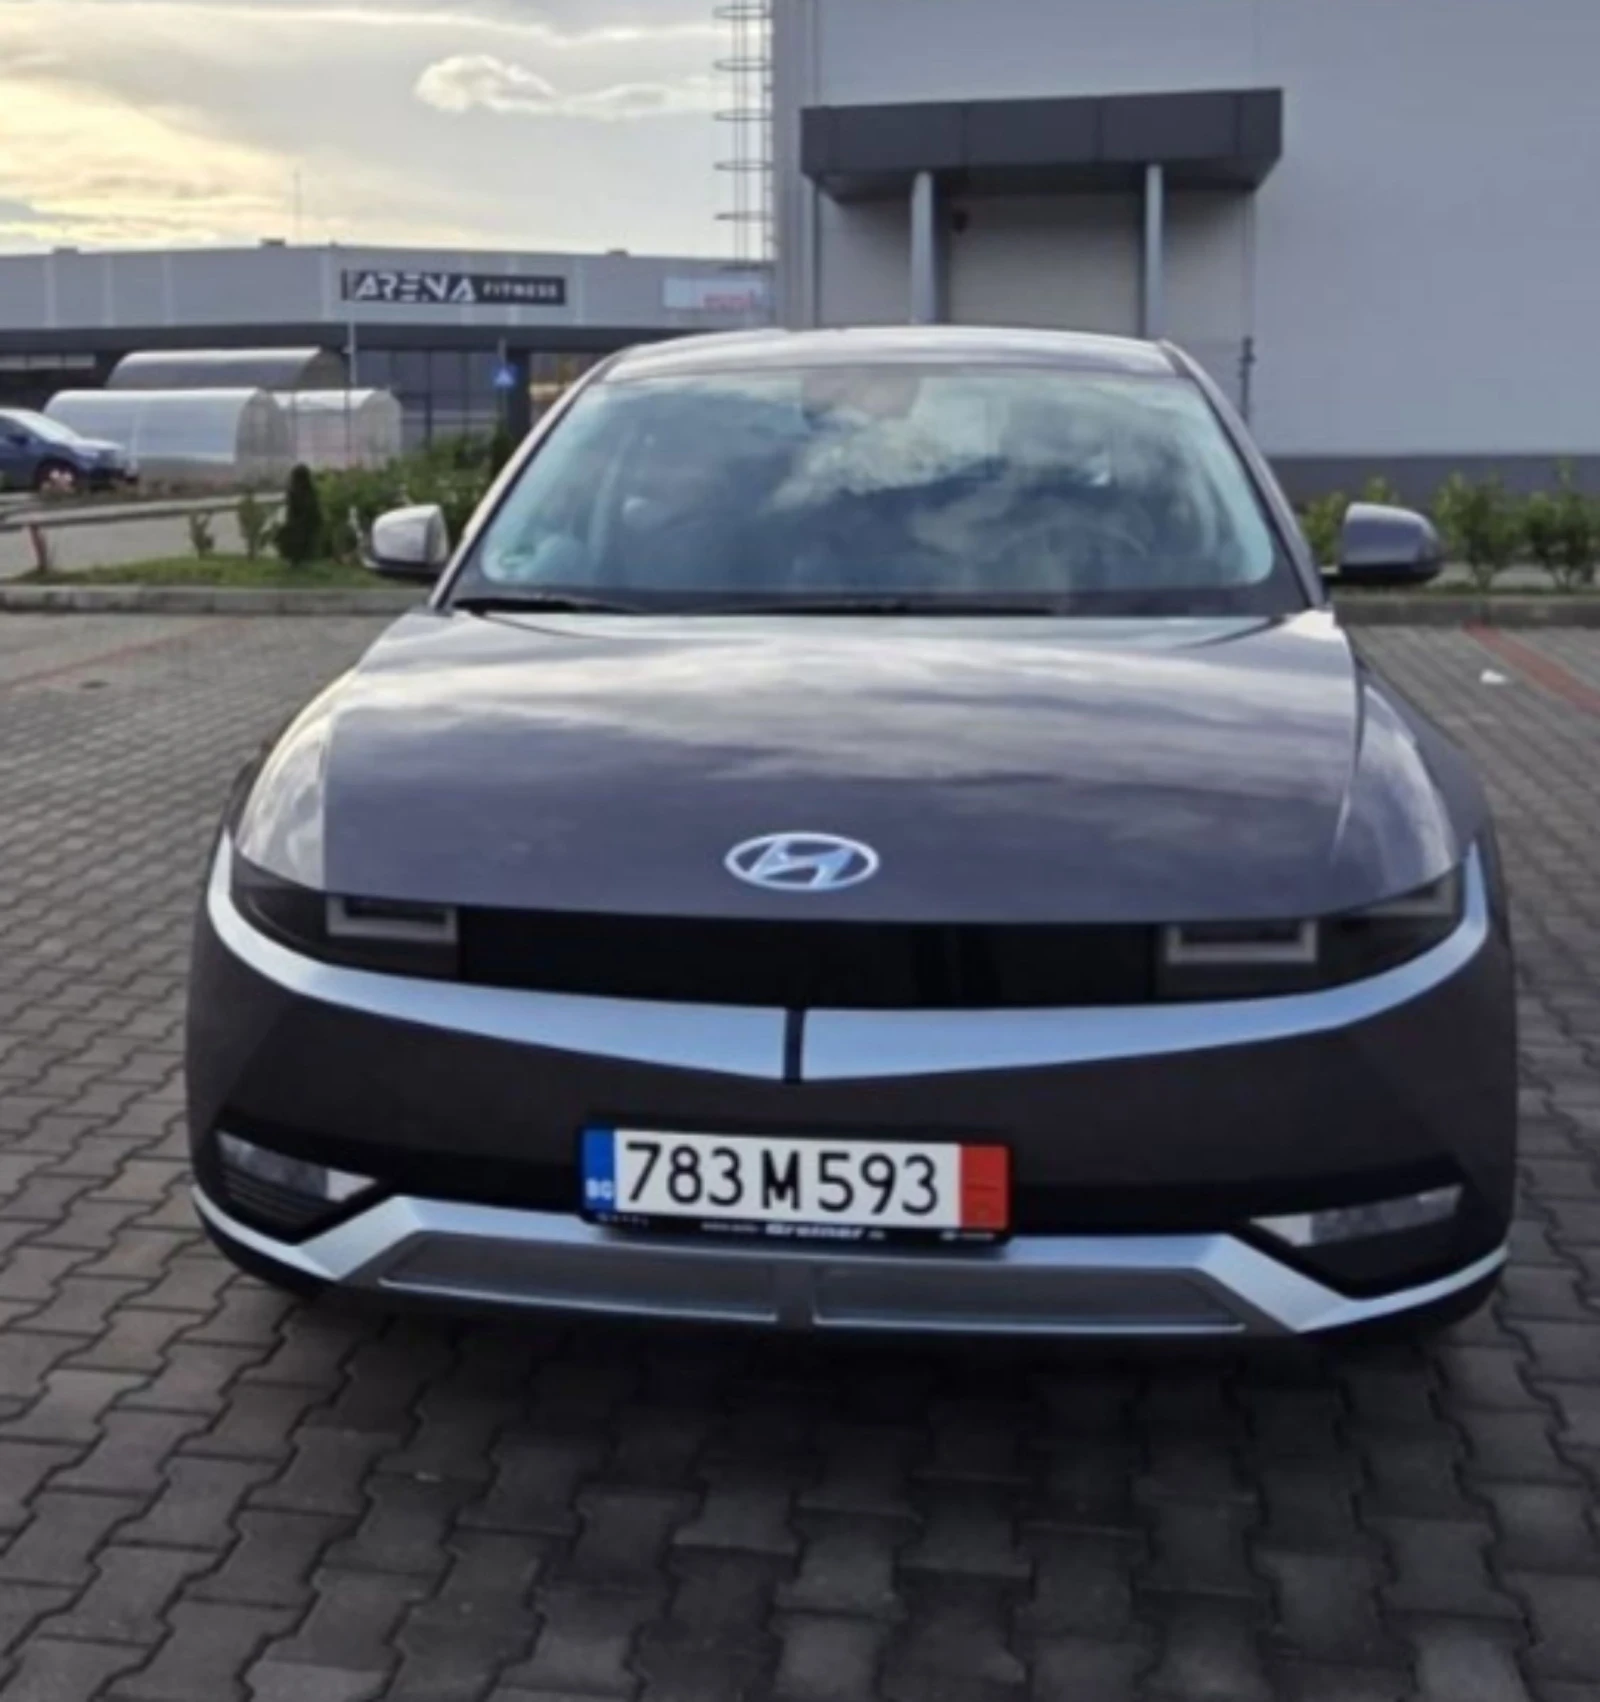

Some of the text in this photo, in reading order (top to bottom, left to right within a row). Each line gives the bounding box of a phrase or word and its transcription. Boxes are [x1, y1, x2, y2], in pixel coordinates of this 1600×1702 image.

[355, 272, 558, 302] ARENA FITNESS
[626, 1142, 938, 1216] 783 M 593
